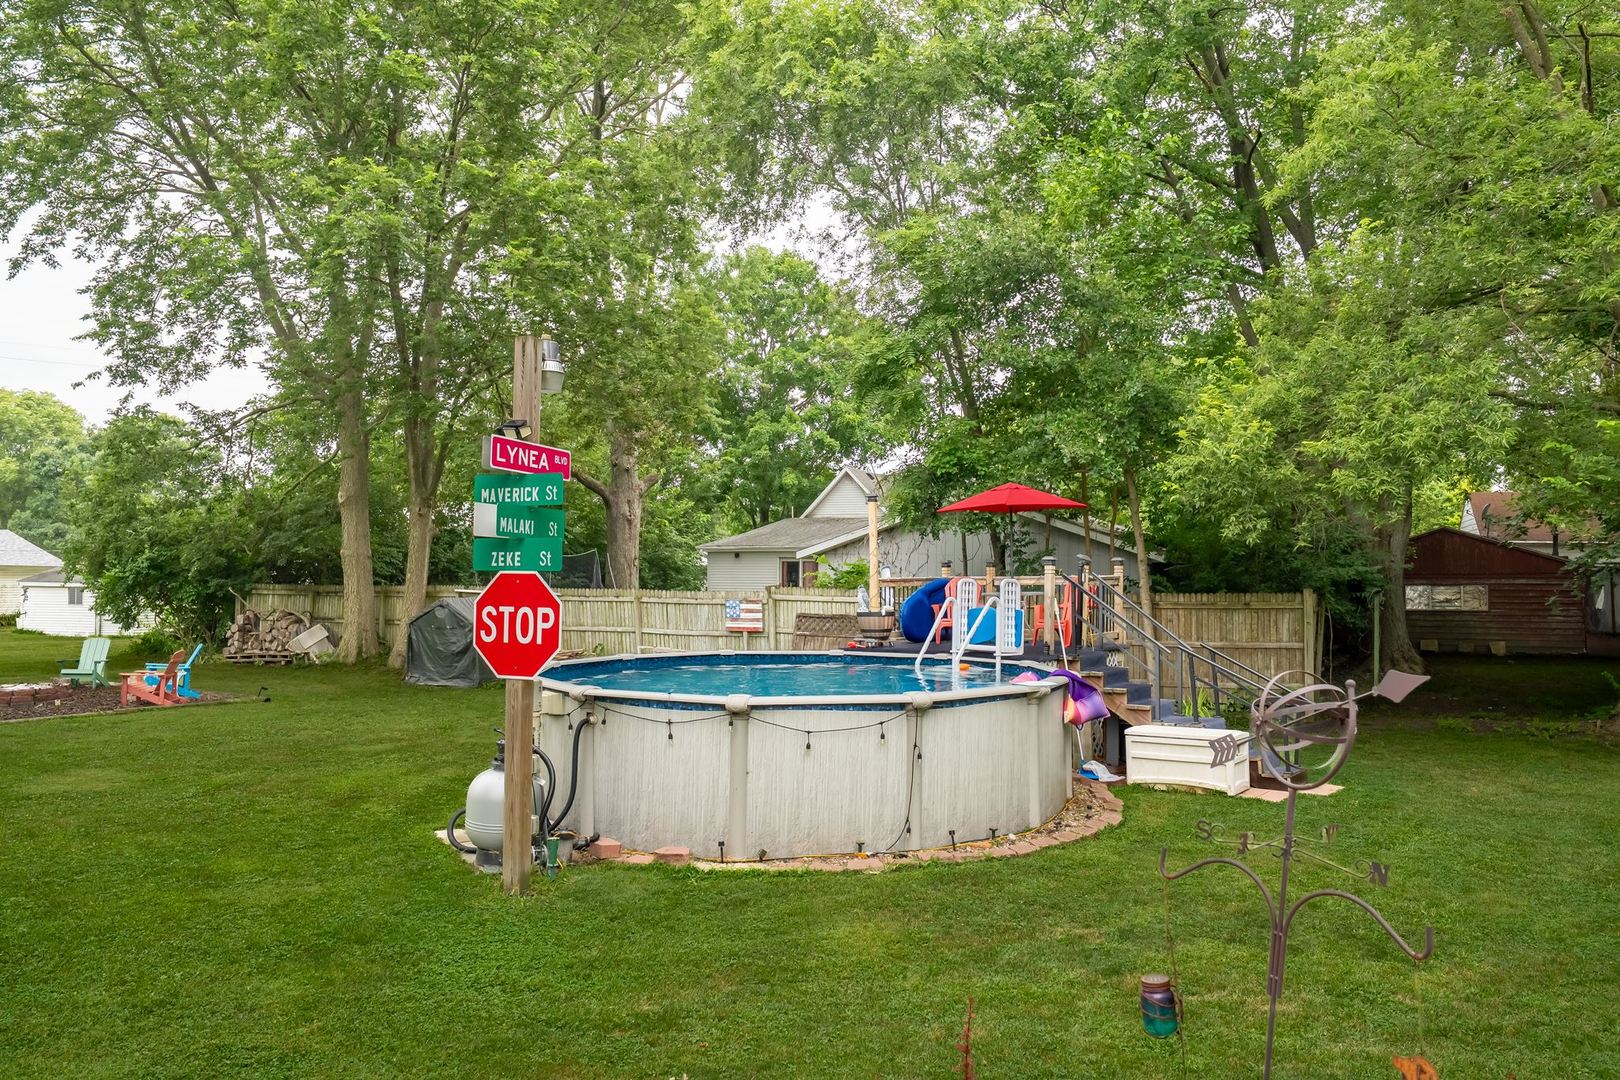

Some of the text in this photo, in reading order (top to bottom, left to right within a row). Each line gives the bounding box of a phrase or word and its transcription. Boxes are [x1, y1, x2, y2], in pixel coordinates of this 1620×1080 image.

[496, 443, 568, 470] LYNEA BLVD
[481, 485, 558, 503] MAVERICK St
[500, 517, 558, 537] MALAKI St
[491, 550, 552, 567] ZEKE St
[480, 605, 555, 645] STOP
